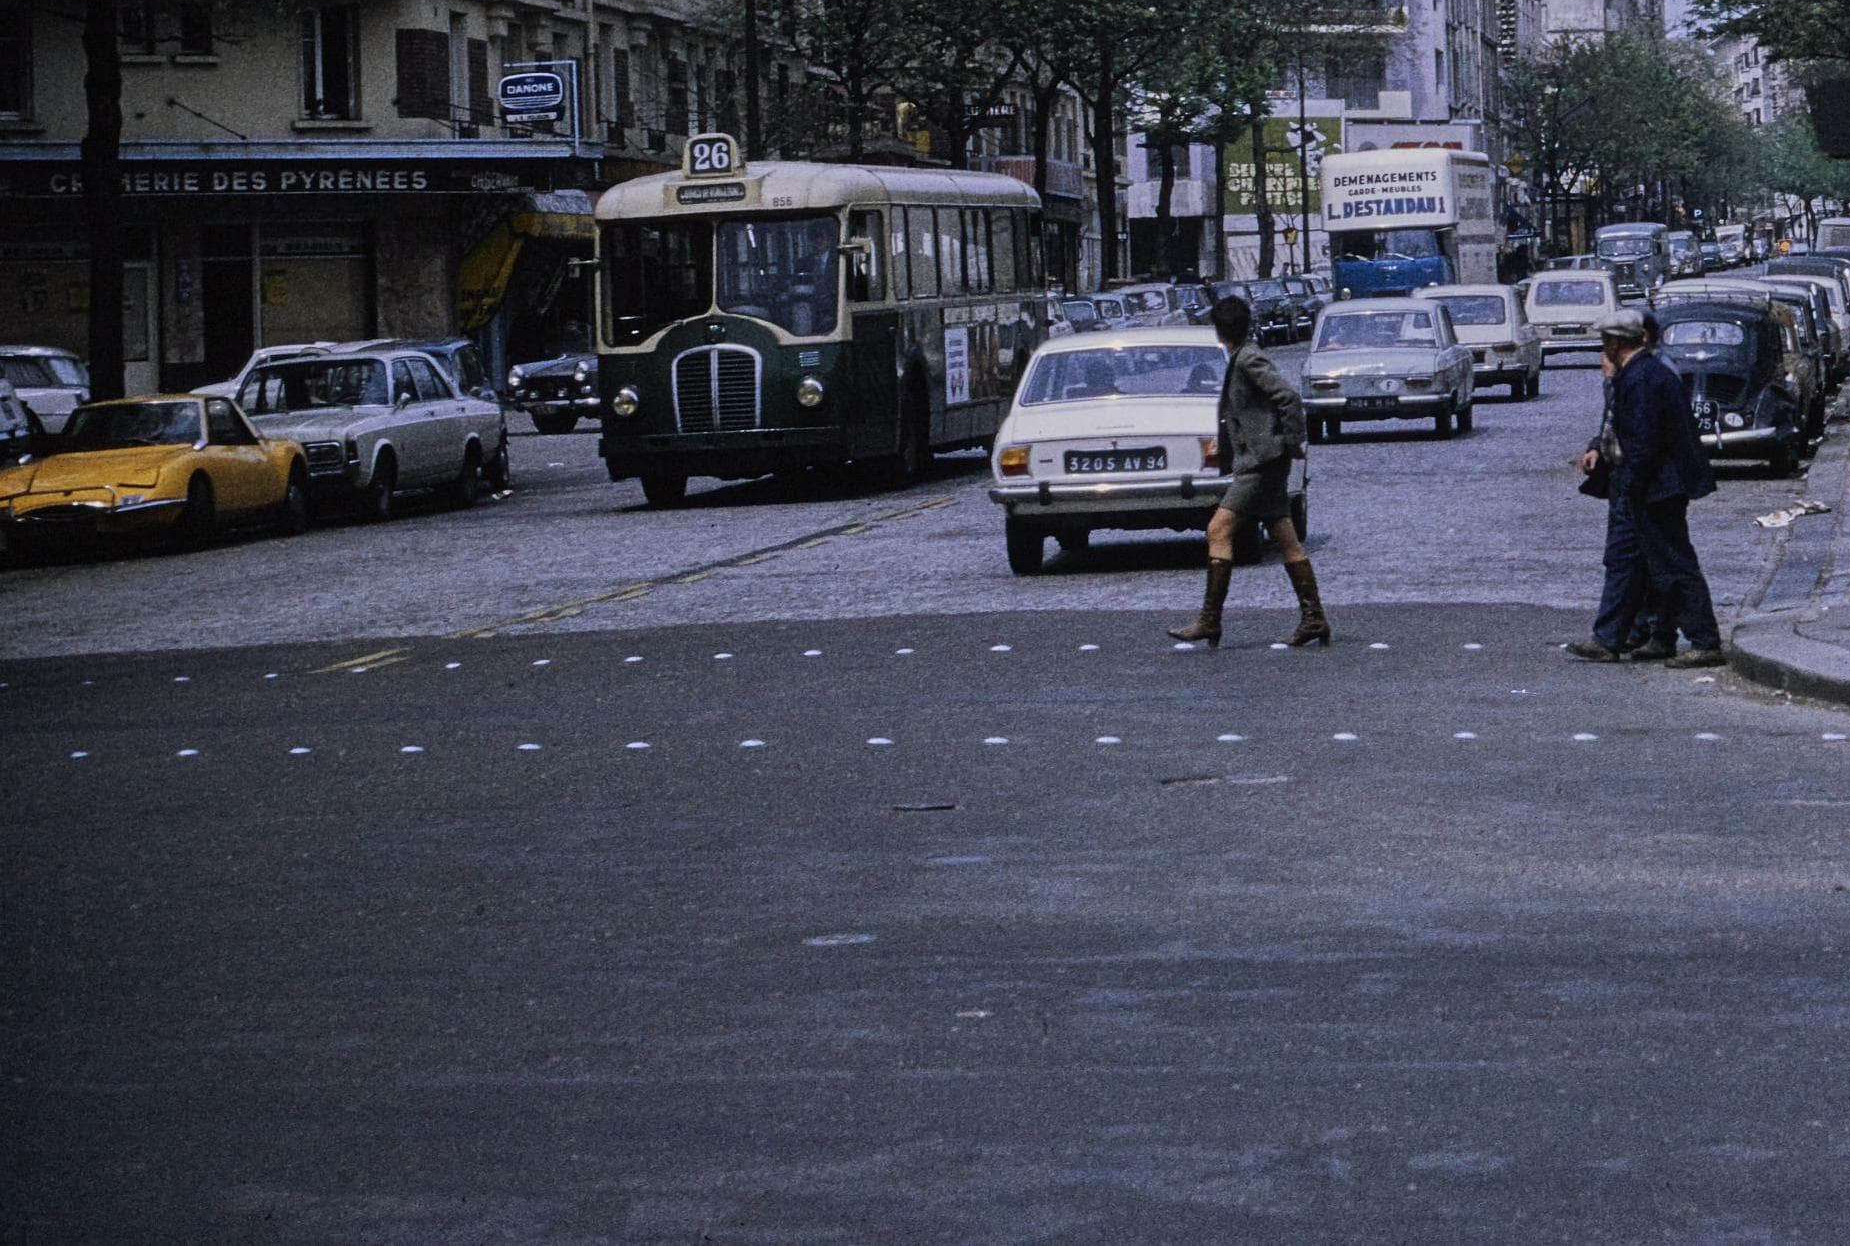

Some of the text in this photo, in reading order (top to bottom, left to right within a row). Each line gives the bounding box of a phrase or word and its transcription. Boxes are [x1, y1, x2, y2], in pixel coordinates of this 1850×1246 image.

[506, 82, 554, 95] DANONE
[693, 141, 730, 171] 26
[212, 170, 268, 192] DES
[1693, 208, 1703, 219] P
[1069, 455, 1166, 472] 3205 AV 94
